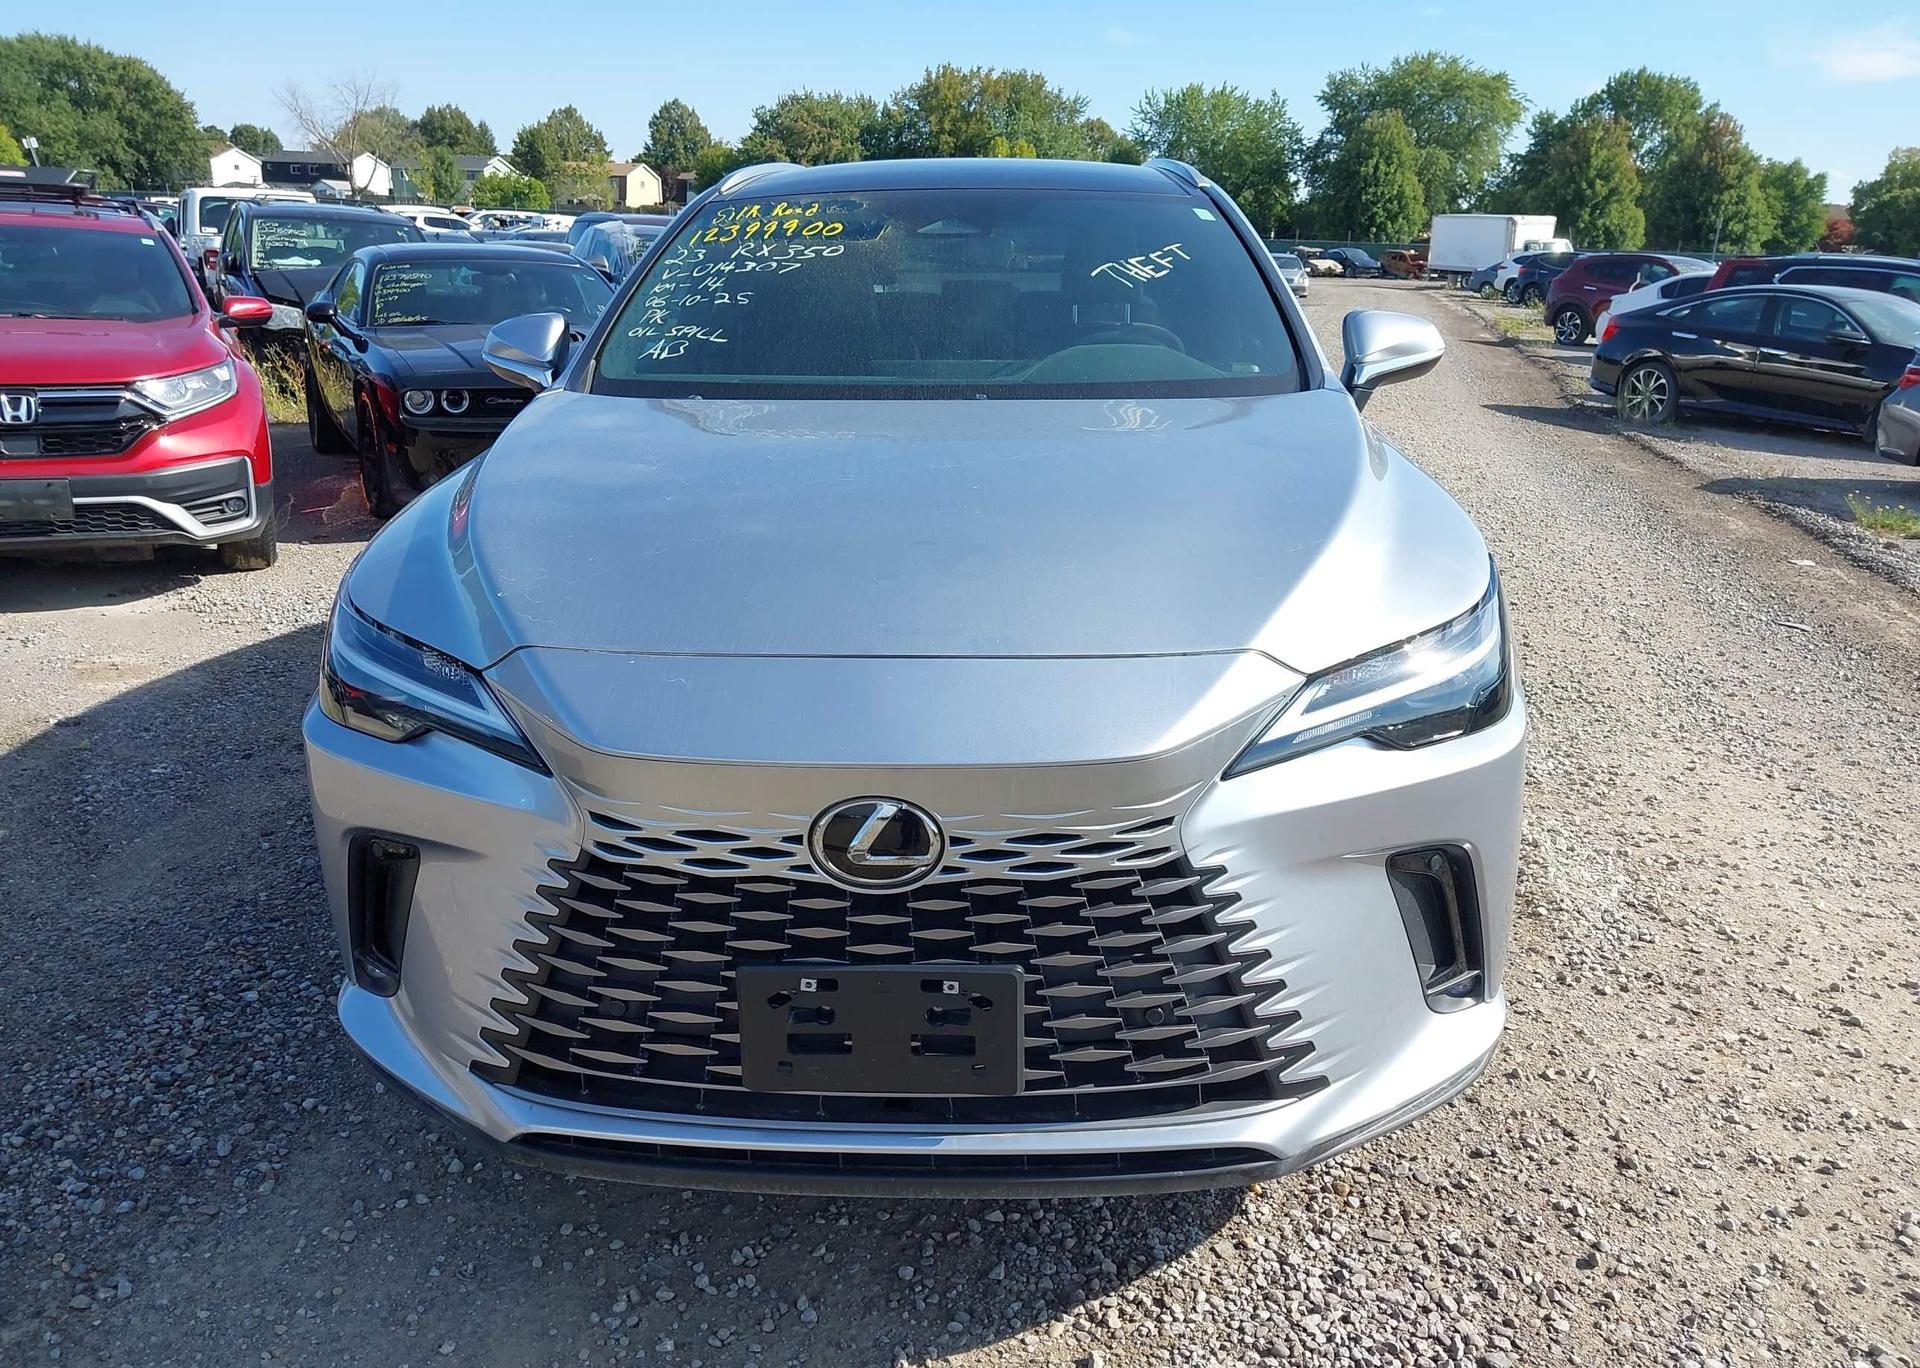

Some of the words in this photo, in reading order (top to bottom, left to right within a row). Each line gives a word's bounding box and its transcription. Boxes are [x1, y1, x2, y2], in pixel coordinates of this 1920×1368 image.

[690, 219, 844, 247] 12399900
[664, 249, 707, 266] 23
[1090, 242, 1192, 289] THEFT
[628, 327, 661, 338] OIL
[665, 325, 729, 343] SPILL
